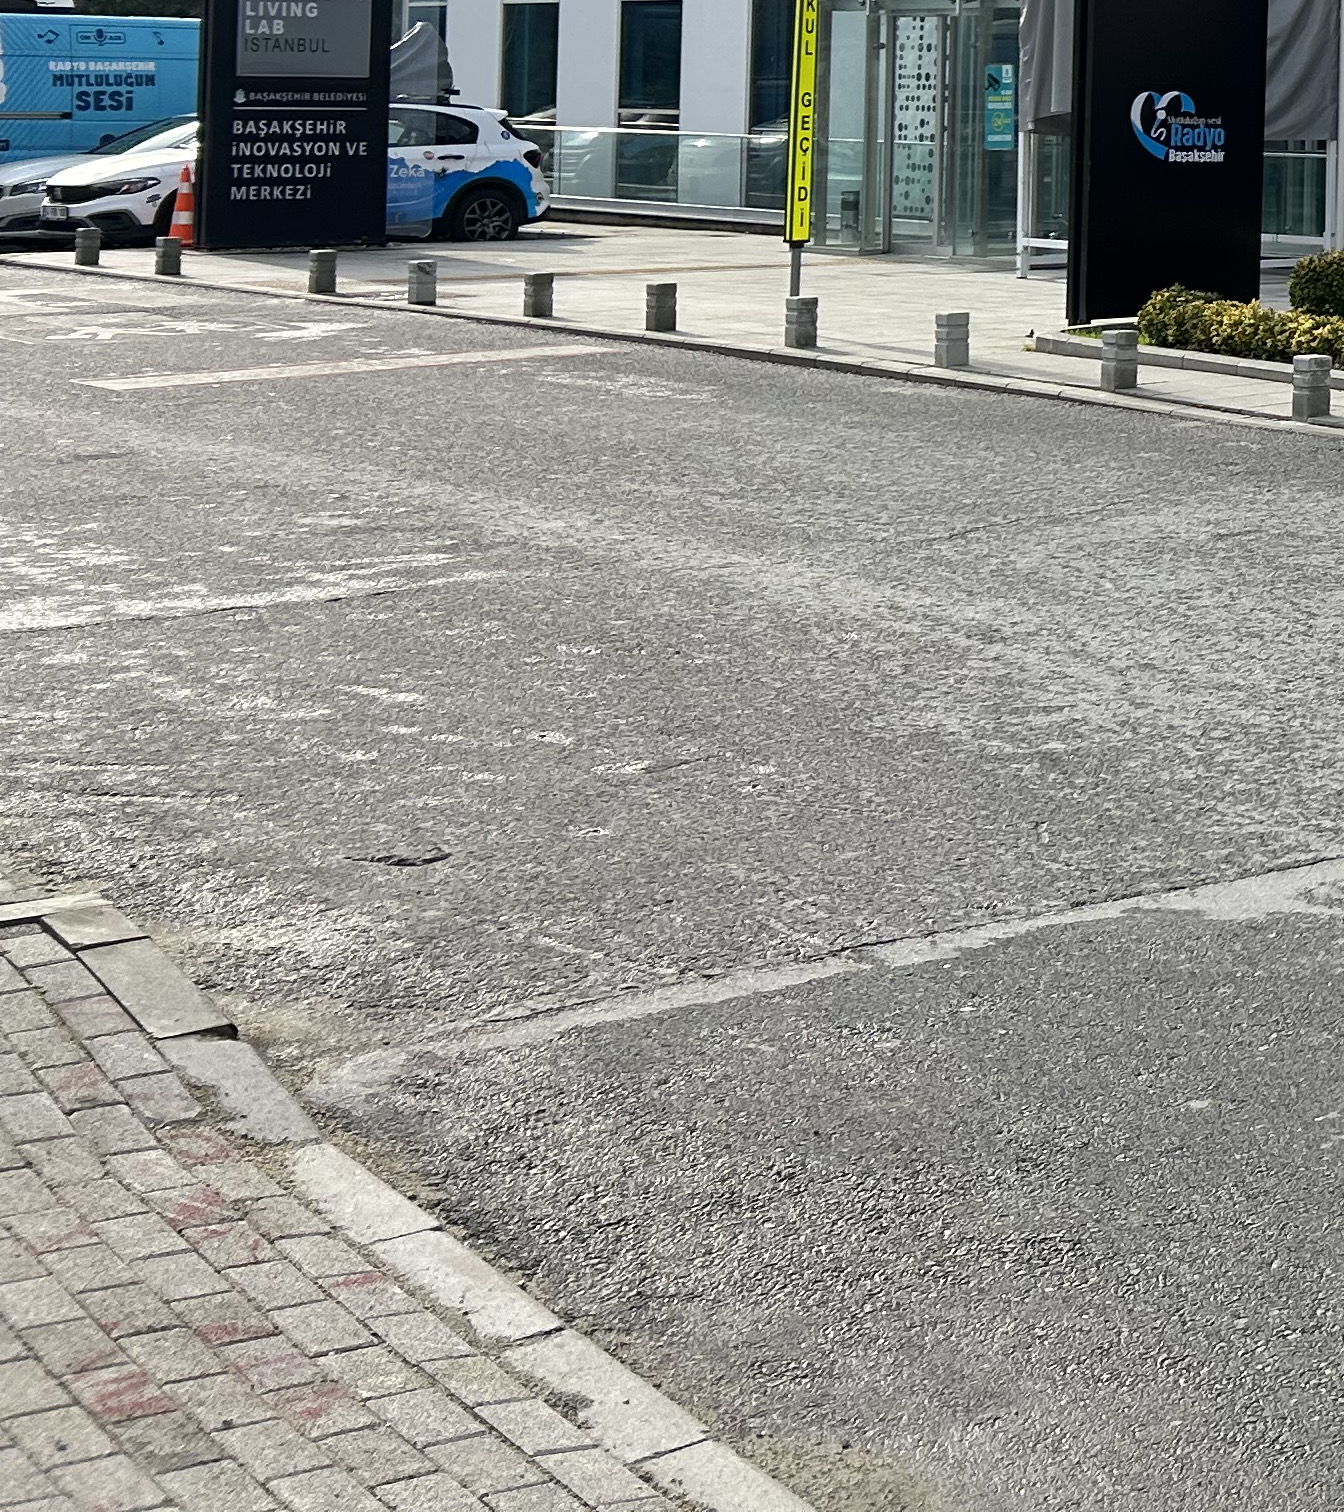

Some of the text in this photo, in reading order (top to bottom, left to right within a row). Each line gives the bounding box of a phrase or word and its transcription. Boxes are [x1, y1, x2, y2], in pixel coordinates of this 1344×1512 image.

[245, 1, 319, 18] LIVING
[245, 19, 285, 35] LAB
[243, 37, 330, 53] ISTANBUL
[1170, 122, 1226, 150] Radyo
[346, 142, 368, 156] VE
[798, 91, 812, 228] GEÇİDİ
[389, 165, 425, 178] Zeka
